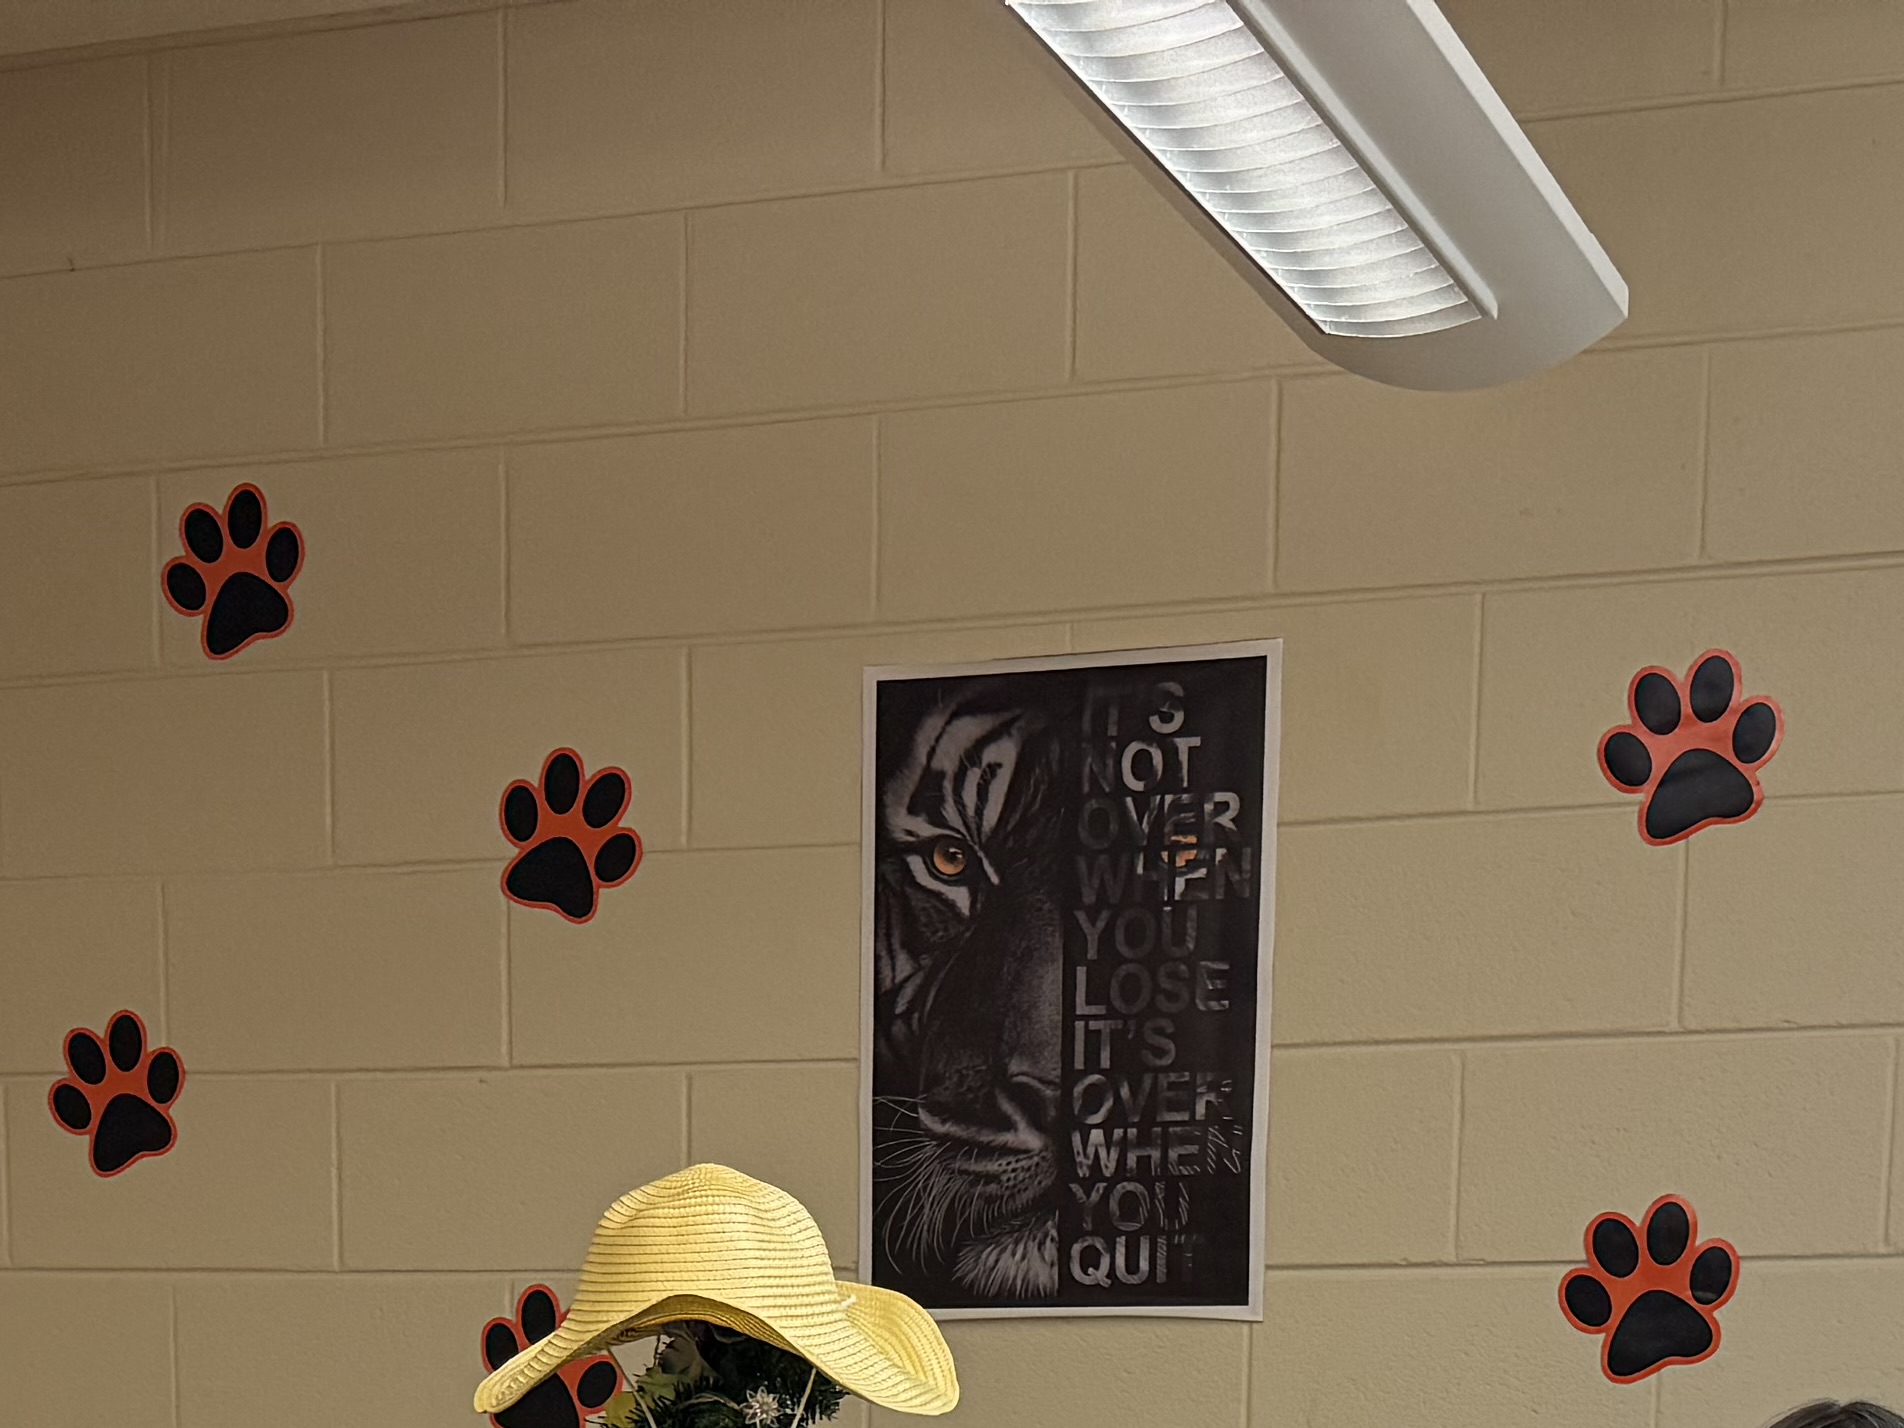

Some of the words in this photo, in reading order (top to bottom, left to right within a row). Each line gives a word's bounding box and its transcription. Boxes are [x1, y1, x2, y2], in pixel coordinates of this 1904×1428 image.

[1081, 681, 1185, 734] ITS
[1081, 736, 1202, 793] NOT
[1078, 792, 1242, 849] OVER
[1076, 847, 1252, 906] WHEN
[1073, 907, 1198, 961] YOU
[1074, 960, 1231, 1016] LOSE
[1073, 1017, 1177, 1070] IT'S
[1072, 1071, 1235, 1124] OVER
[1070, 1125, 1245, 1178] WHEN
[1069, 1180, 1191, 1232] YOU
